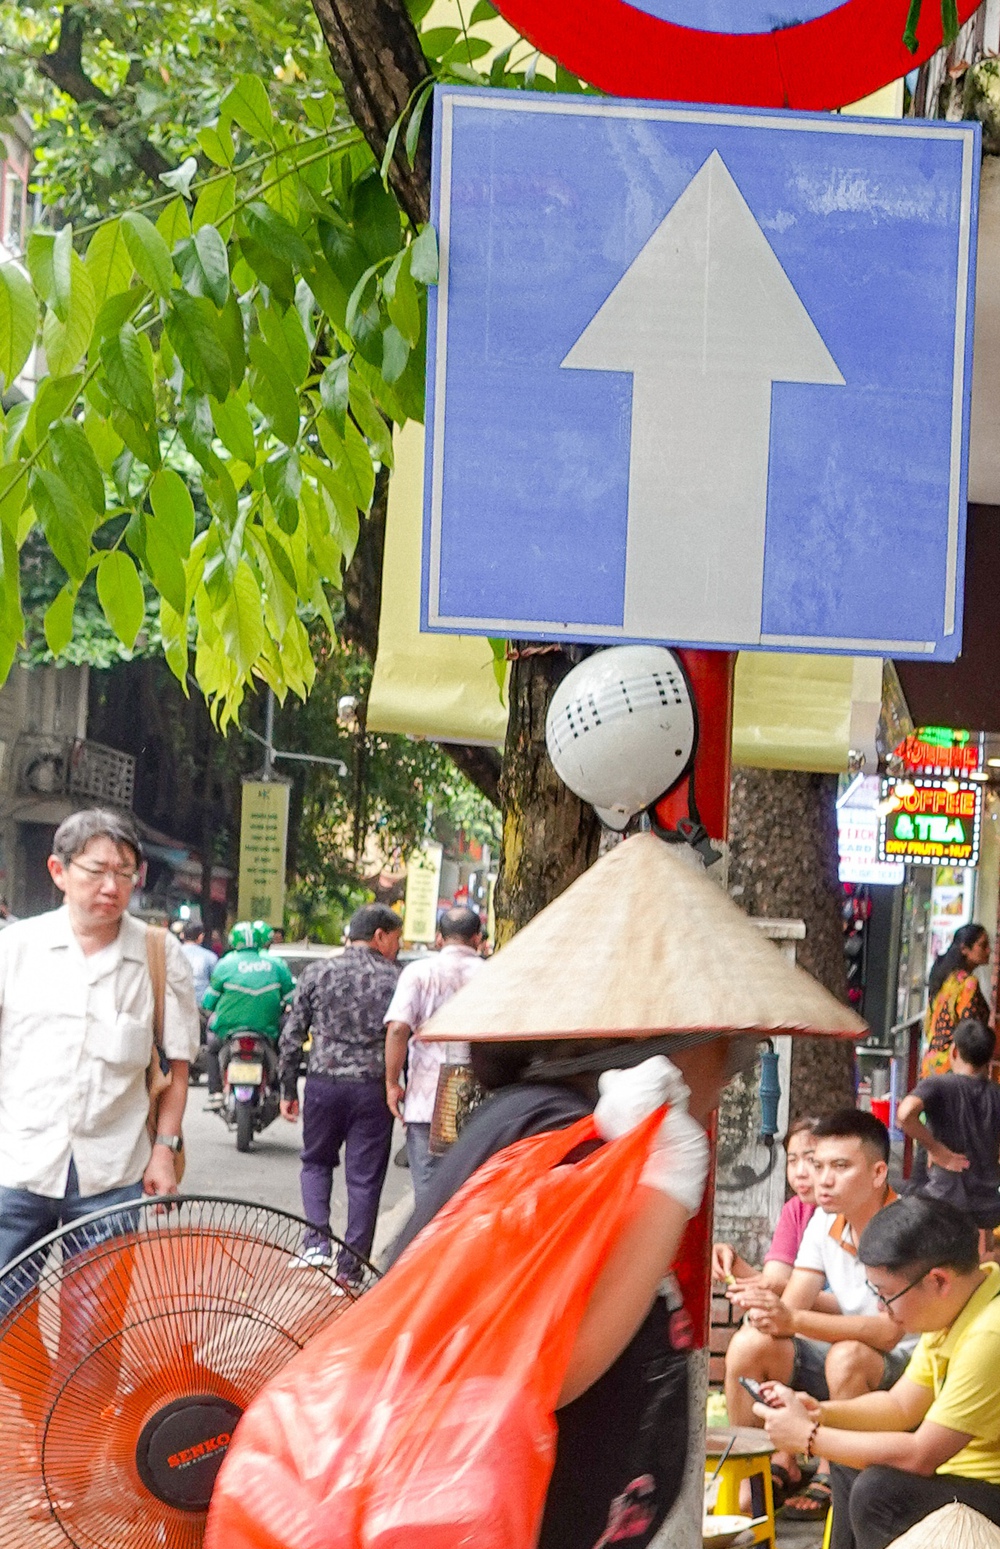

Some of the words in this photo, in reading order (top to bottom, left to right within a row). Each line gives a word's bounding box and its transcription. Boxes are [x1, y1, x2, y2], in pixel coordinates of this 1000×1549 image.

[895, 813, 914, 839] &
[914, 814, 965, 843] TEA
[886, 840, 907, 854] DRY
[949, 844, 972, 858] NUT
[238, 960, 272, 974] Grab
[167, 1432, 231, 1468] SENKO
